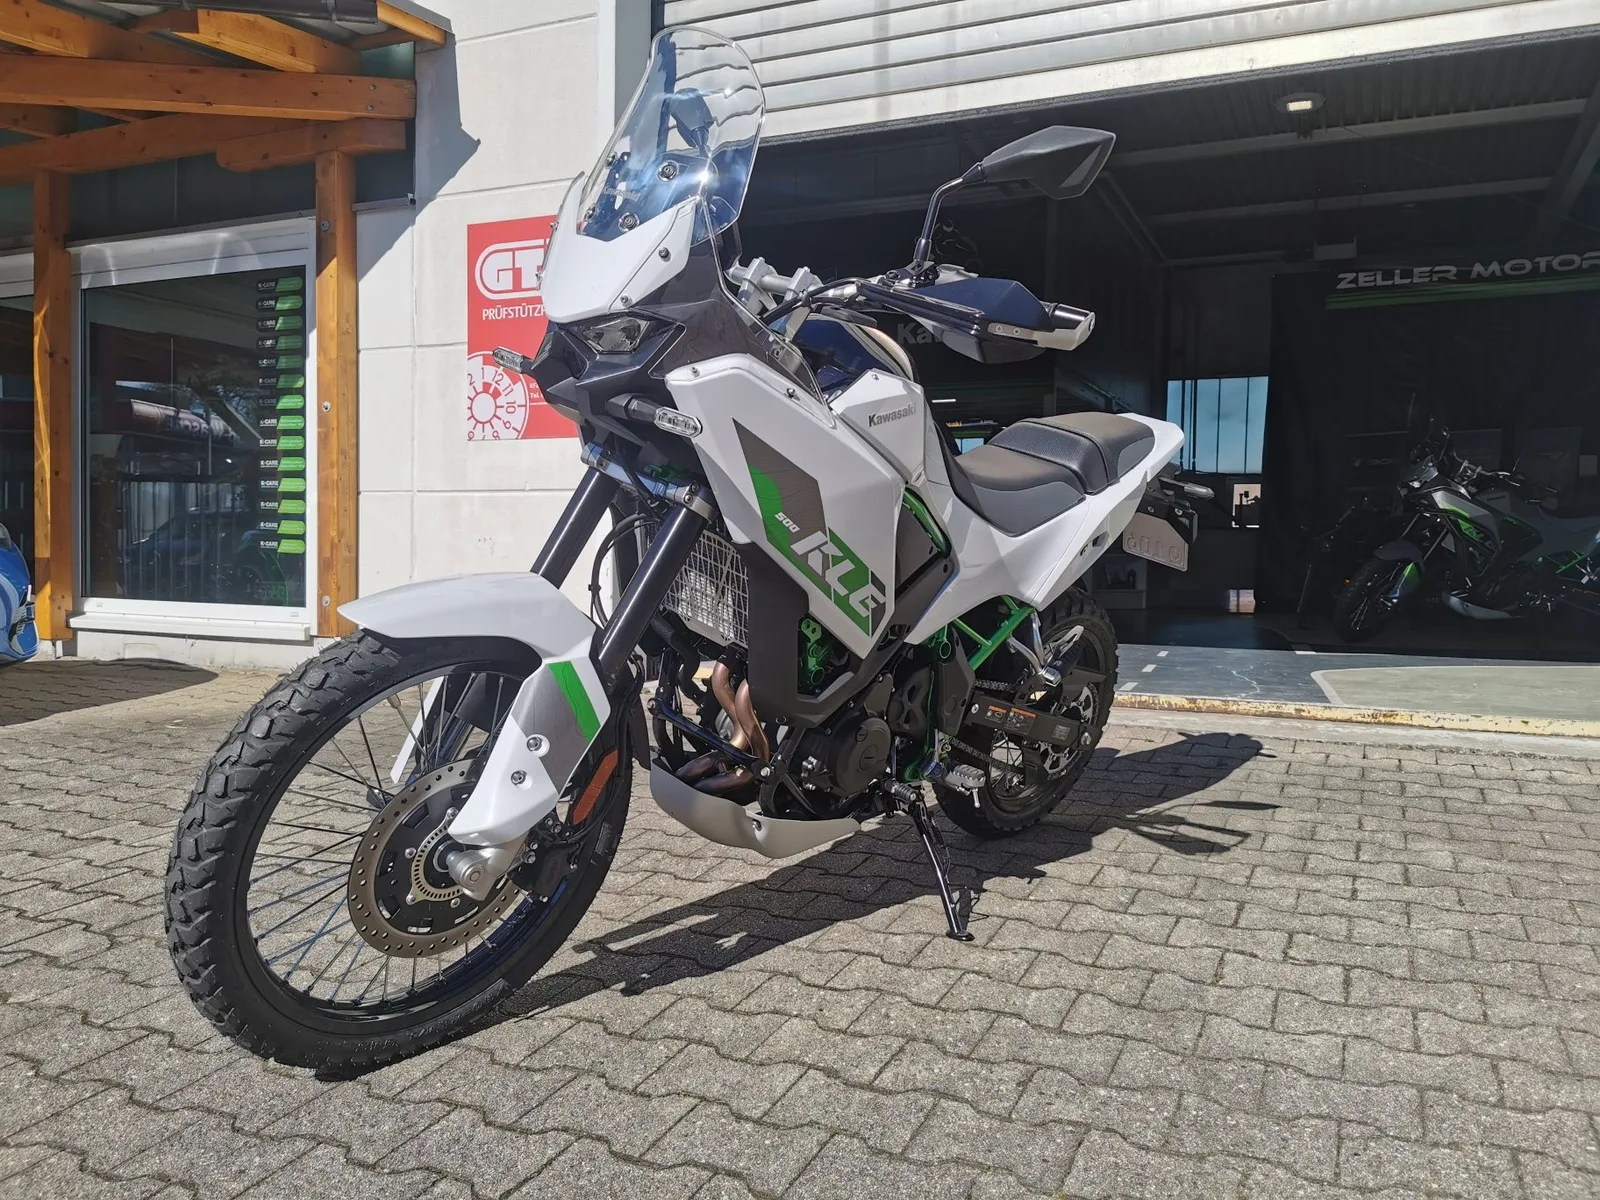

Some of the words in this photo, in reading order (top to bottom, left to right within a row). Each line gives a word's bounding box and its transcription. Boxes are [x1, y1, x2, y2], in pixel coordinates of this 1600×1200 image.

[1336, 265, 1458, 290] ZELLER
[897, 322, 942, 345] Ka
[868, 402, 917, 428] Kawasaki
[774, 510, 801, 534] 500
